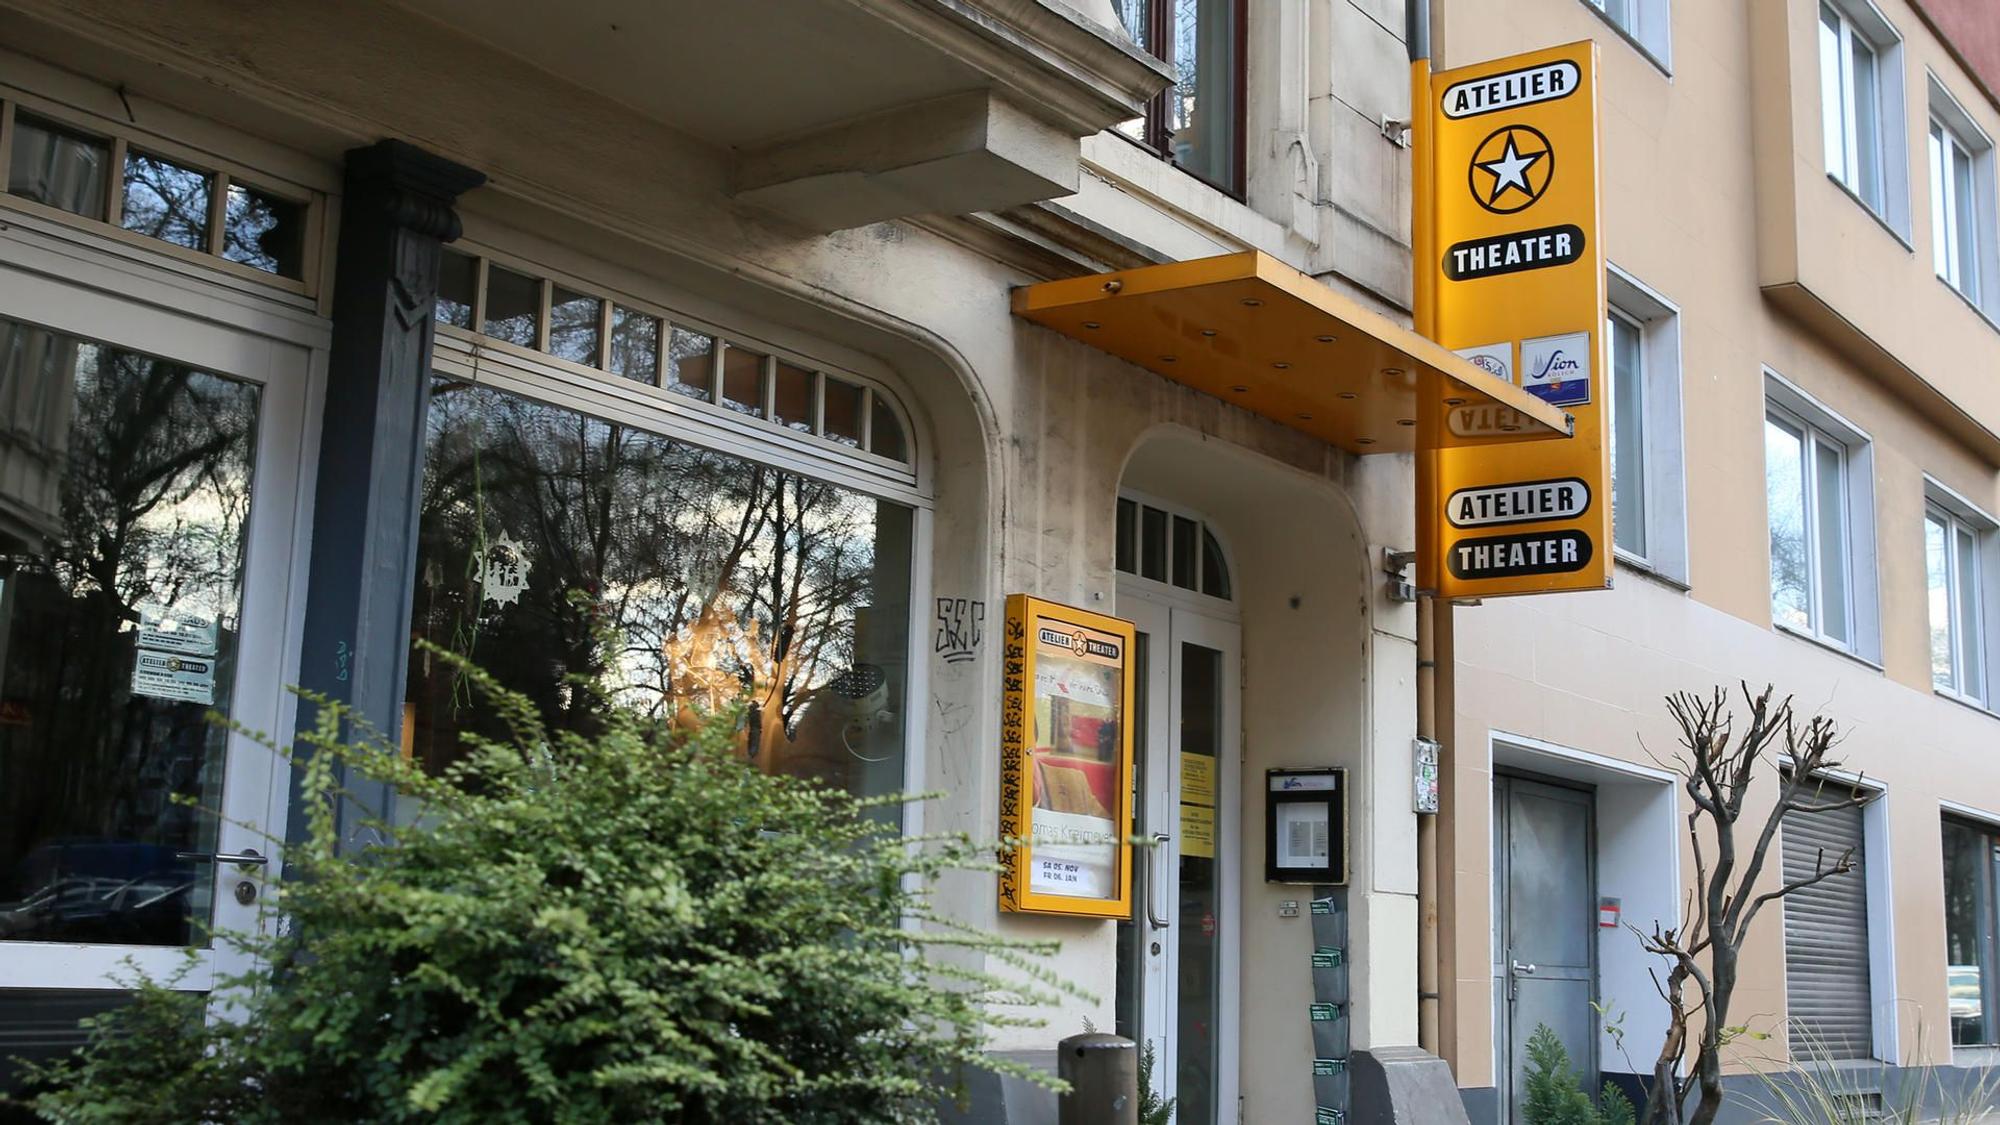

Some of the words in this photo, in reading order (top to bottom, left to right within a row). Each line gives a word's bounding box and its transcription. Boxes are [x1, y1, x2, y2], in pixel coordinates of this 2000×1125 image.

[1454, 68, 1566, 113] ATELIER
[1453, 232, 1572, 273] THEATER
[1532, 350, 1579, 379] Sion
[1459, 486, 1574, 520] ATELIER
[1458, 538, 1578, 571] THEATER
[1041, 631, 1070, 646] ATELIER
[1088, 641, 1117, 657] THEATER
